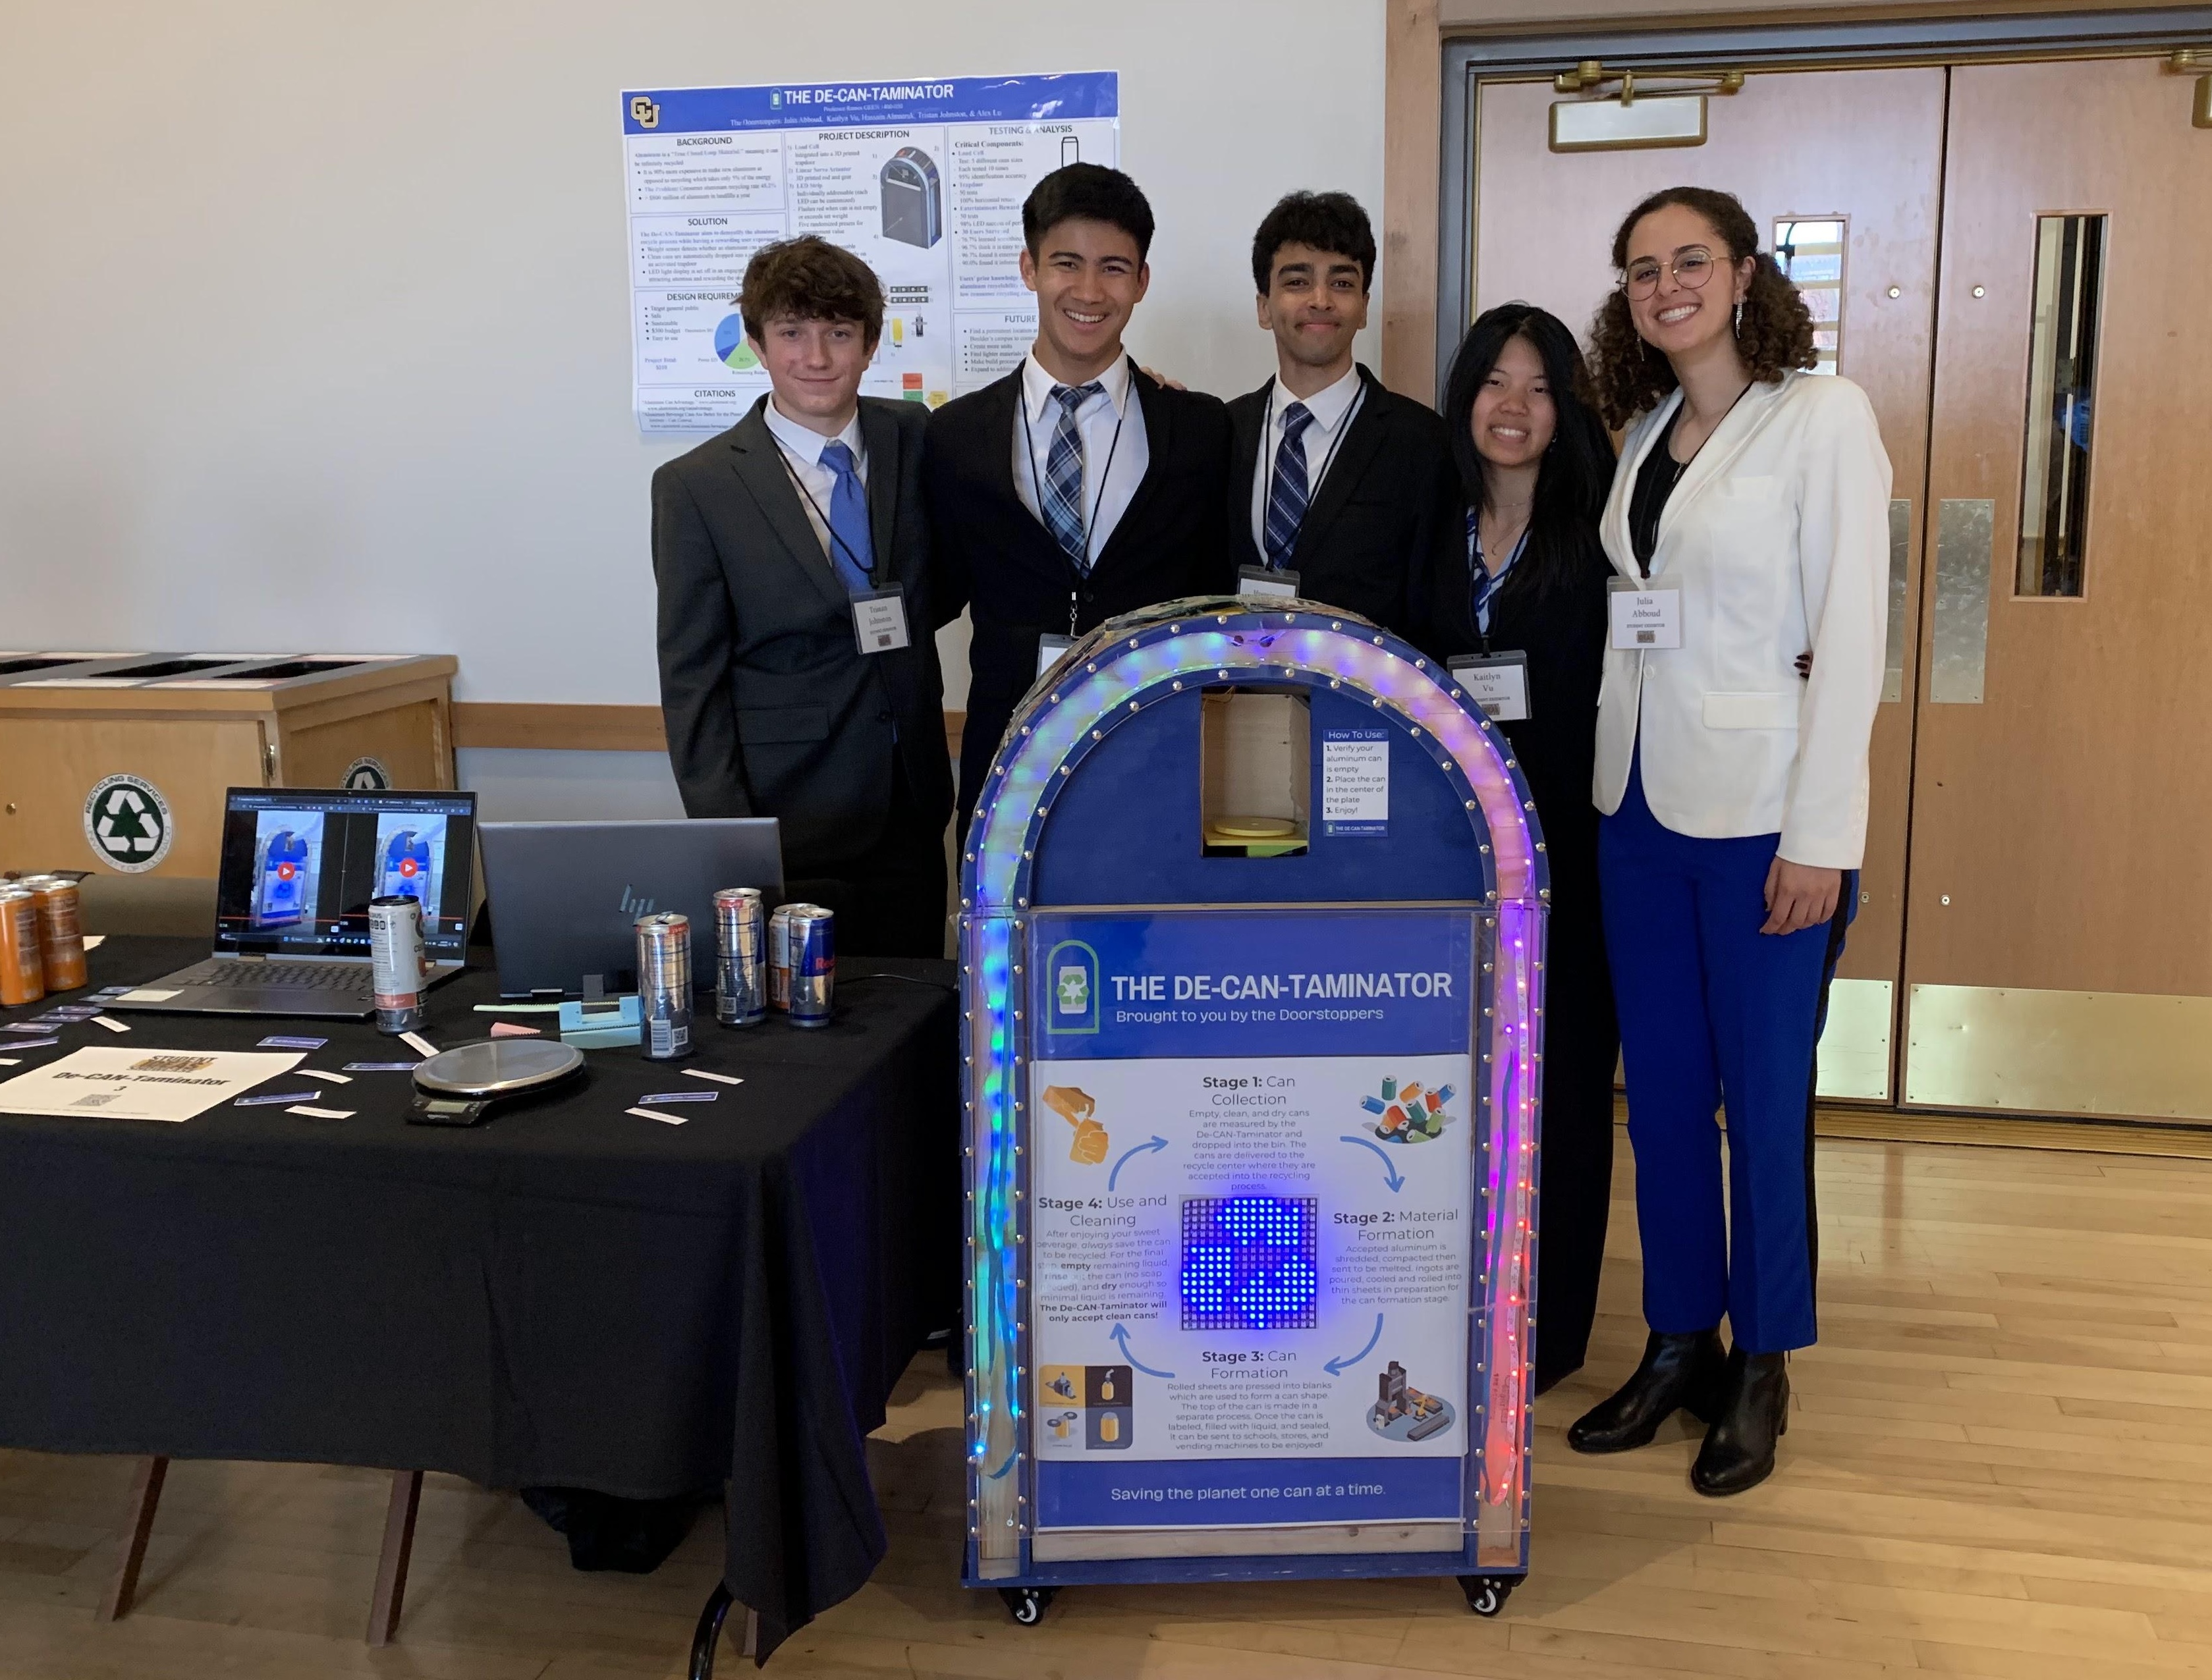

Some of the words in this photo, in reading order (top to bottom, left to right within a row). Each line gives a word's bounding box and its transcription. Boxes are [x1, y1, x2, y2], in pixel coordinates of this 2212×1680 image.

[784, 90, 810, 103] THE
[814, 84, 953, 103] DE-CAN-TAMINATOR
[855, 130, 909, 139] DESCRIPTION
[677, 137, 732, 146] BACKGROUND
[698, 292, 742, 301] REQUIREM
[1637, 597, 1653, 605] Julia
[1632, 609, 1660, 617] Abboud
[1474, 672, 1500, 682] Kaitlyn
[86, 776, 124, 814] RECYCLING
[127, 776, 167, 815] SERVICES
[1111, 976, 1165, 1000] THE
[1175, 973, 1451, 1000] DE-CAN-TAMINATOR
[1117, 1010, 1177, 1023] Brought
[1181, 1010, 1196, 1021] to
[1200, 1012, 1226, 1023] you
[1230, 1010, 1248, 1022] by
[1252, 1010, 1275, 1021] the
[1280, 1008, 1383, 1021] Doorstoppers
[52, 1073, 230, 1085] De-CAN-Taminator
[1203, 1077, 1248, 1090] Stage
[1252, 1076, 1261, 1087] 1:
[1267, 1076, 1294, 1087] Can
[1212, 1093, 1285, 1105] Collection
[1271, 1109, 1286, 1118] dry
[1267, 1120, 1278, 1129] by
[1234, 1151, 1275, 1160] delivered
[1183, 1162, 1214, 1171] recycle
[1279, 1161, 1298, 1170] they
[1188, 1172, 1229, 1181] accepted
[1232, 1173, 1250, 1181] into
[1251, 1172, 1267, 1181] the
[1268, 1172, 1310, 1181] recycling
[1039, 1197, 1083, 1212] Stage
[1088, 1197, 1101, 1208] 4:
[1107, 1197, 1134, 1208] Use
[1139, 1195, 1166, 1206] and
[1070, 1214, 1135, 1228] Cleaning
[1334, 1212, 1377, 1226] Stage
[1383, 1211, 1394, 1222] 2:
[1400, 1209, 1457, 1221] Material
[1358, 1228, 1433, 1240] Formation
[1060, 1301, 1147, 1311] De-CAN-Taminator
[1049, 1314, 1068, 1323] only
[1072, 1314, 1103, 1322] accept
[1202, 1351, 1246, 1365] Stage
[1251, 1351, 1263, 1361] 3:
[1268, 1350, 1296, 1361] Can
[1211, 1367, 1287, 1378] Formation
[1111, 1488, 1163, 1502] Saving
[1167, 1488, 1193, 1499] the
[1198, 1487, 1246, 1500] planet
[1250, 1488, 1279, 1498] one
[1283, 1487, 1312, 1497] can
[1316, 1484, 1331, 1496] at
[1335, 1486, 1344, 1495] a
[1348, 1483, 1385, 1495] time.
